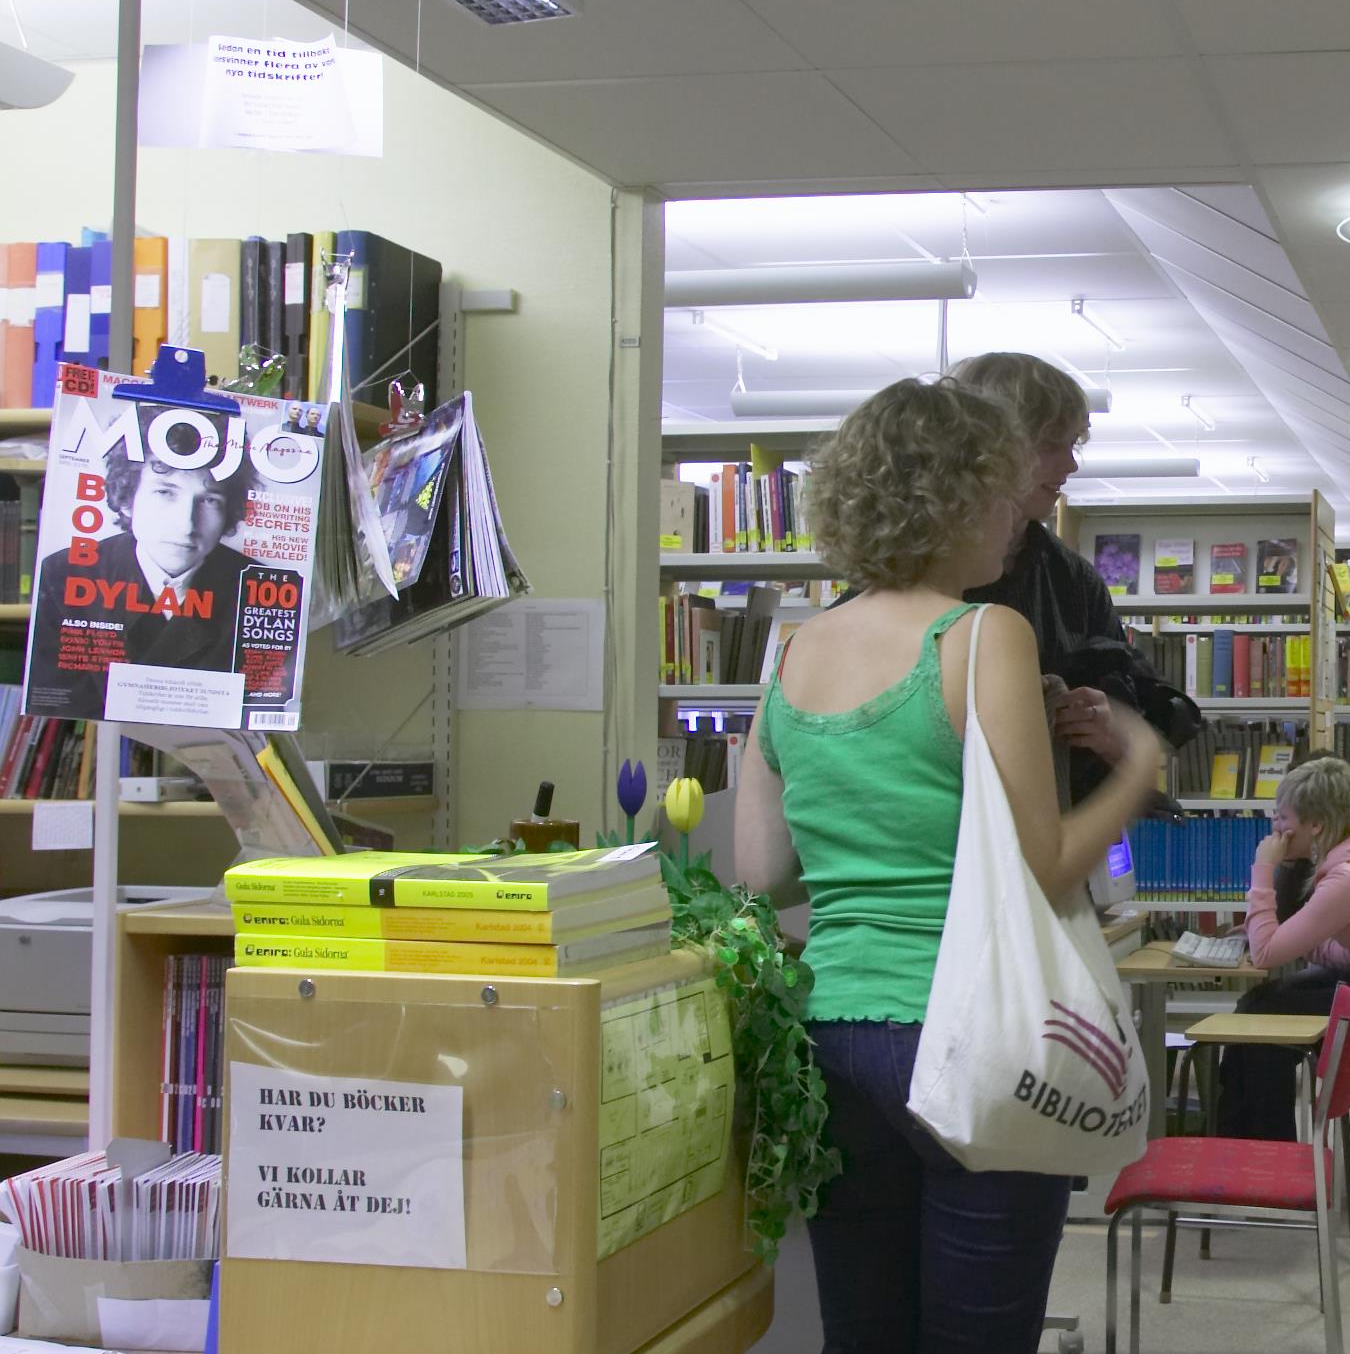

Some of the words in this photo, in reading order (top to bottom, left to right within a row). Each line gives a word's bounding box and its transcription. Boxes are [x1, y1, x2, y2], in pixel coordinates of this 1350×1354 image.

[60, 397, 320, 484] MOJO
[274, 504, 289, 514] ON
[293, 506, 311, 515] HIS
[68, 472, 107, 567] BOB
[245, 517, 310, 532] SECRETS
[243, 538, 258, 547] LP
[272, 542, 308, 552] MOVIE
[243, 547, 308, 561] REVEALED!
[257, 572, 289, 582] THE
[63, 576, 214, 619] DYLAN
[246, 579, 298, 609] 100
[244, 606, 297, 618] GREATEST
[62, 618, 87, 628] ALSO
[243, 615, 296, 630] DYLAN
[242, 627, 294, 642] SONGS
[236, 882, 251, 890] Gula
[505, 892, 532, 900] eniro
[291, 915, 311, 926] Gula
[311, 916, 345, 927] Sidorna
[476, 922, 512, 932] Karlstad
[293, 947, 313, 958] Gula
[314, 948, 349, 959] Sidorna
[480, 956, 517, 965] Karlstad
[259, 1088, 302, 1107] HAR
[309, 1091, 335, 1108] DU
[342, 1089, 426, 1113] BÖCKER
[259, 1113, 326, 1133] KVAR?
[258, 1165, 278, 1182] VI
[286, 1166, 366, 1186] KOLLAR
[257, 1187, 326, 1210] GÄRNA
[333, 1189, 359, 1212] ÅT
[366, 1196, 411, 1215] DEJ!
